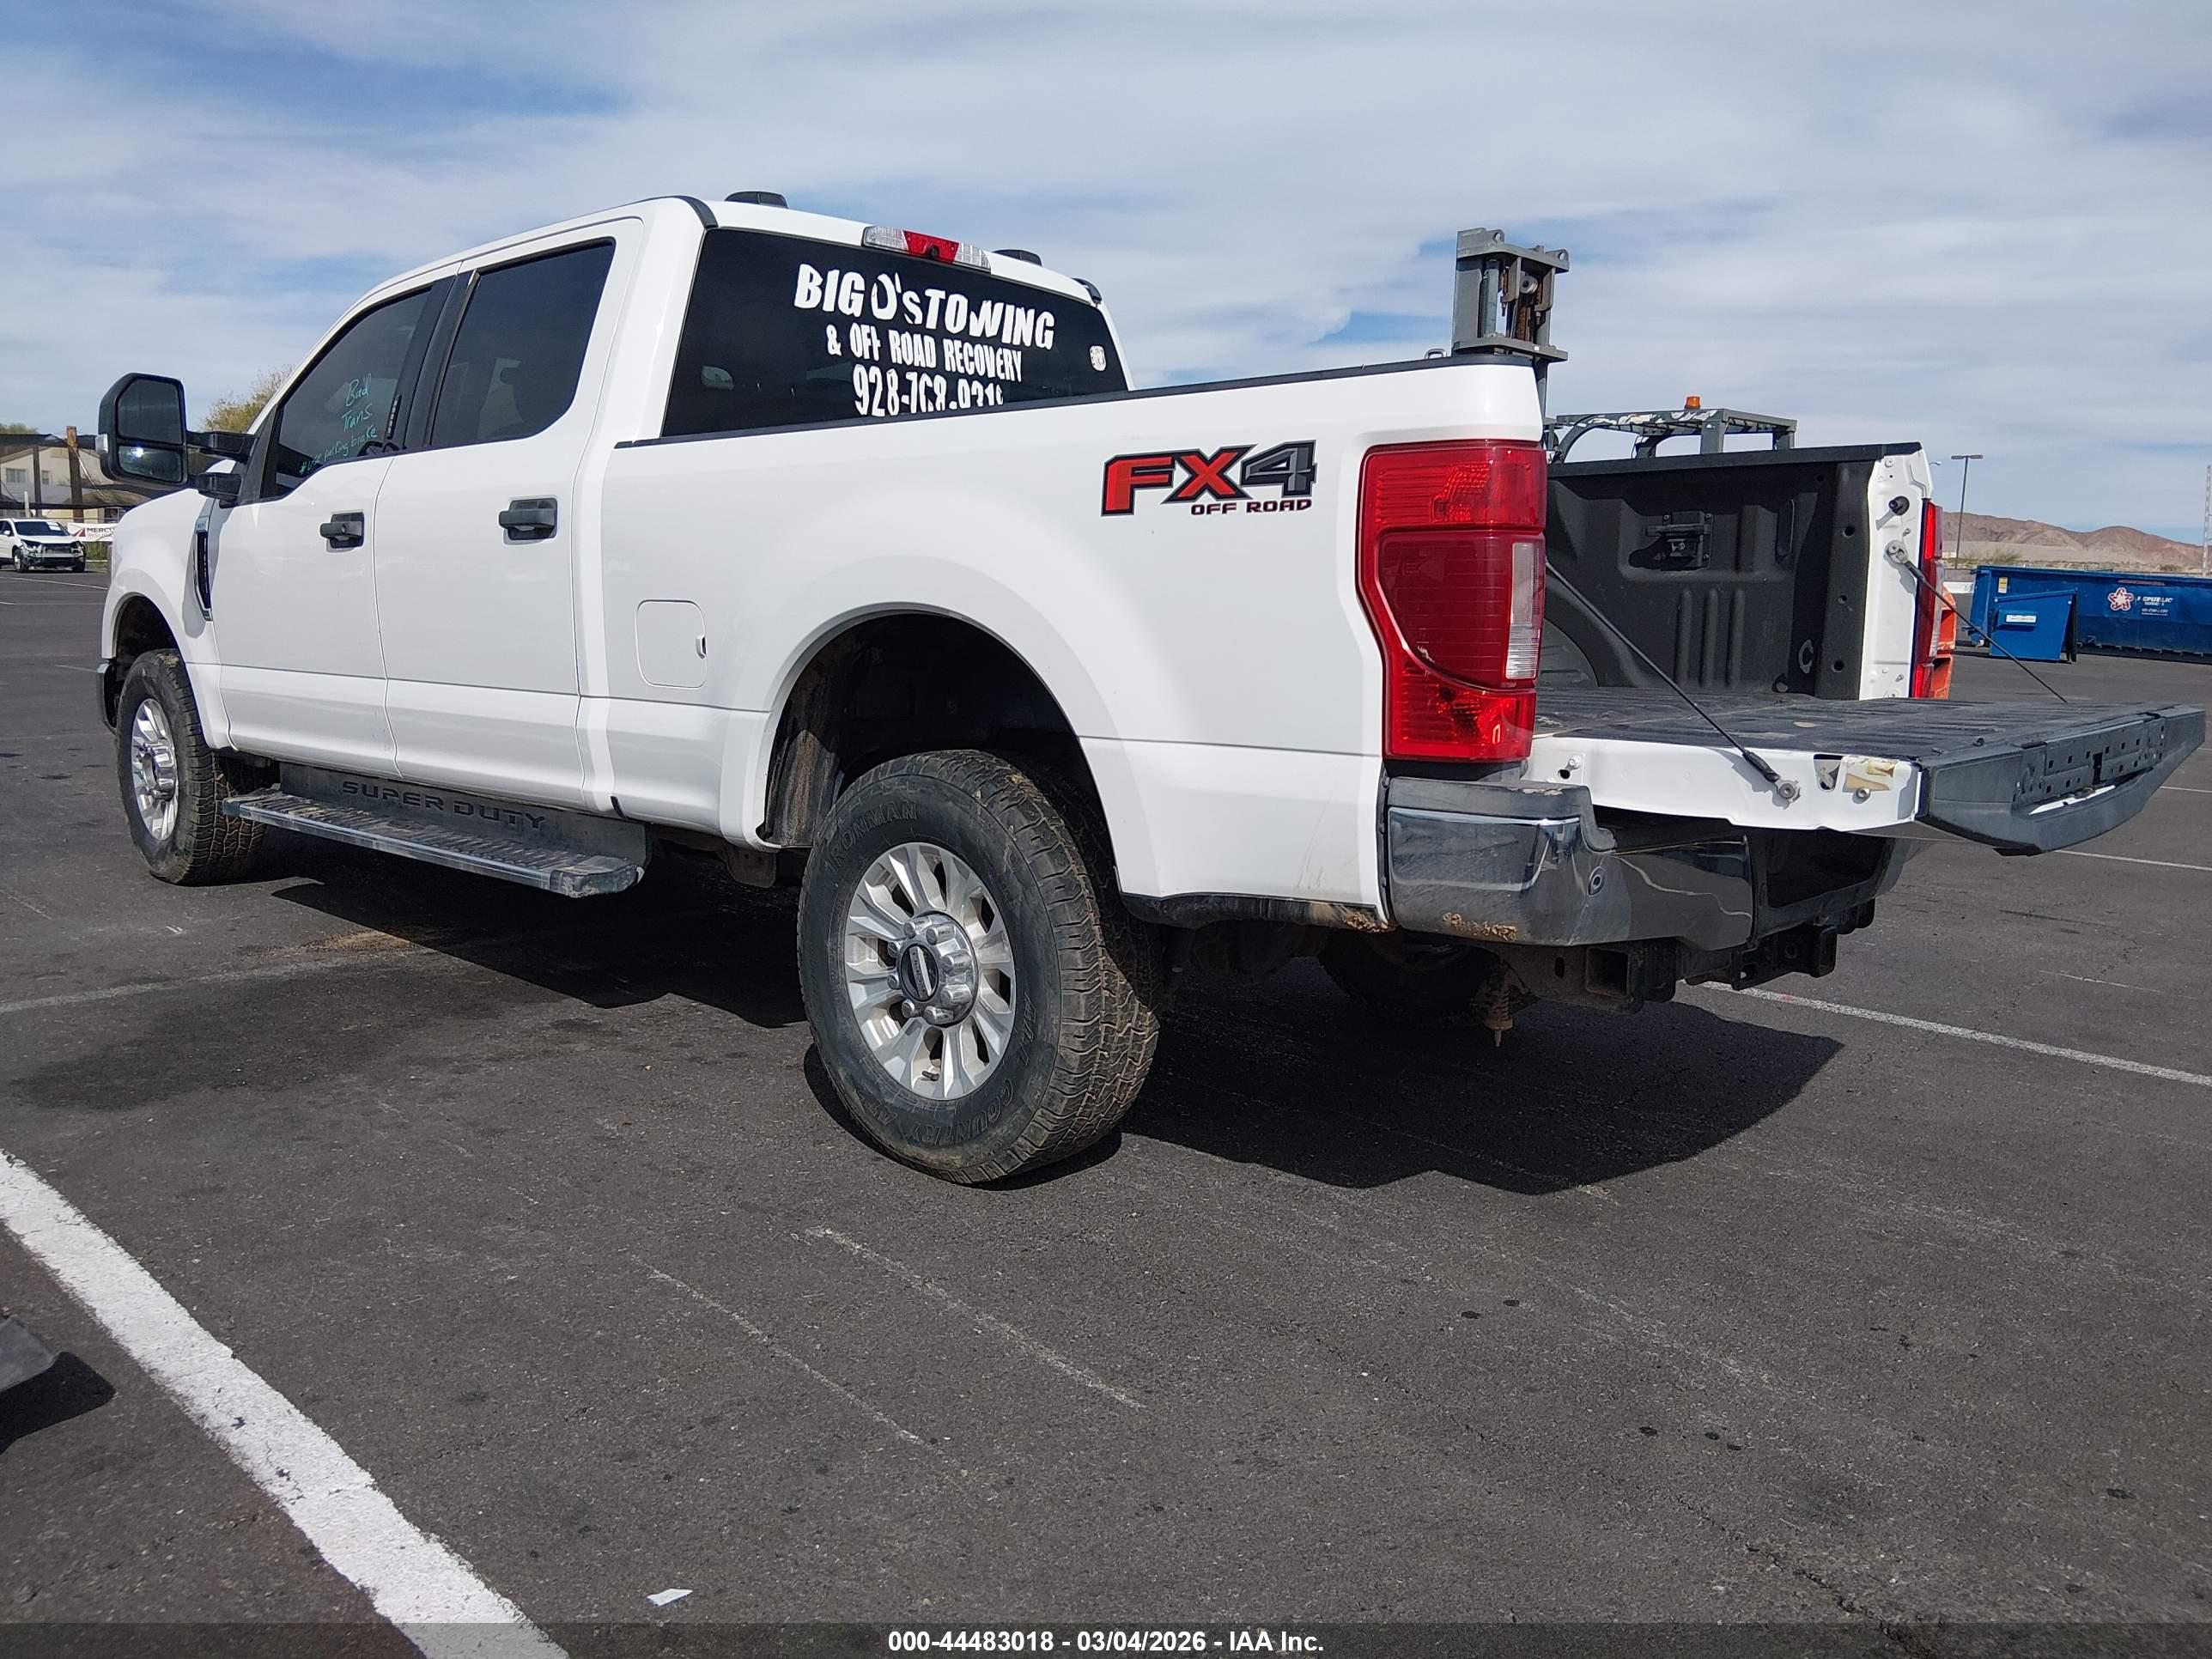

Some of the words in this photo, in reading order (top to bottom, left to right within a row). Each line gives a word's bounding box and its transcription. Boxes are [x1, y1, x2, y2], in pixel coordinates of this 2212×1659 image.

[794, 264, 866, 317] BIG
[925, 289, 1054, 349] TOWING
[826, 324, 842, 356] &
[889, 329, 937, 368] ROAD
[943, 338, 1022, 383] RECOVERY
[342, 404, 373, 431] Trans
[346, 373, 372, 407] Bad
[1100, 440, 1317, 517] FX4
[1190, 502, 1237, 516] OFF
[1246, 498, 1312, 514] ROAD
[343, 781, 444, 811] SUPER
[453, 800, 545, 829] DUTY
[823, 800, 918, 875] IRONMAN
[908, 1079, 1013, 1146] COUNTRY
